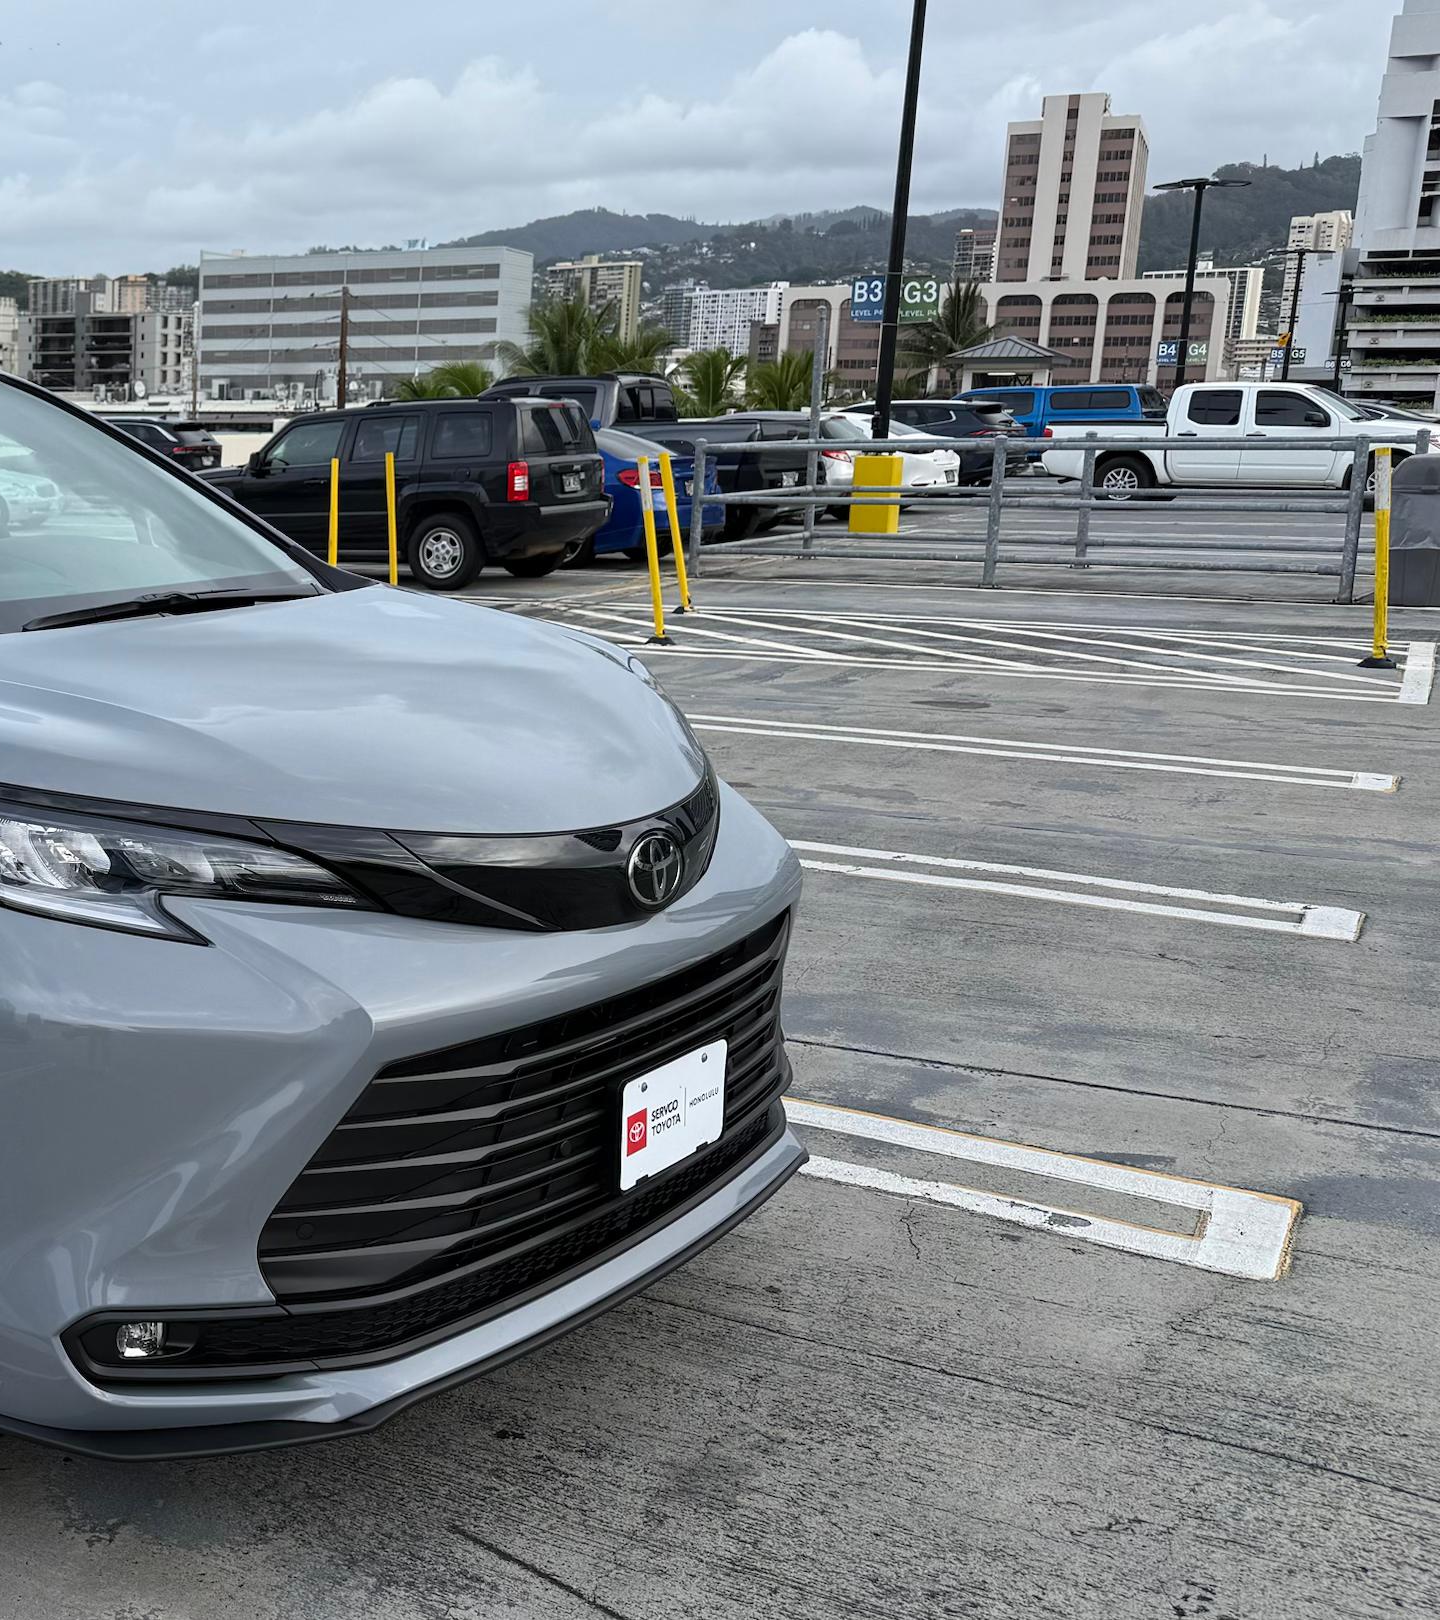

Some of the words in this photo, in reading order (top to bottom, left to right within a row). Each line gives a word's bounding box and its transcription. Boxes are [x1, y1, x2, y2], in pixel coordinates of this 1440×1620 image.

[854, 280, 883, 302] B3
[904, 281, 938, 303] G3
[851, 309, 872, 317] LEVEL
[900, 309, 924, 317] LEVEL
[1159, 344, 1176, 356] B4
[1189, 344, 1207, 355] G4
[1271, 349, 1284, 358] B5
[1291, 349, 1305, 358] G5
[1340, 360, 1352, 368] G6
[689, 1087, 719, 1108] HONOLULU
[651, 1099, 679, 1122] SERVCO
[651, 1113, 681, 1137] TOYOTA
